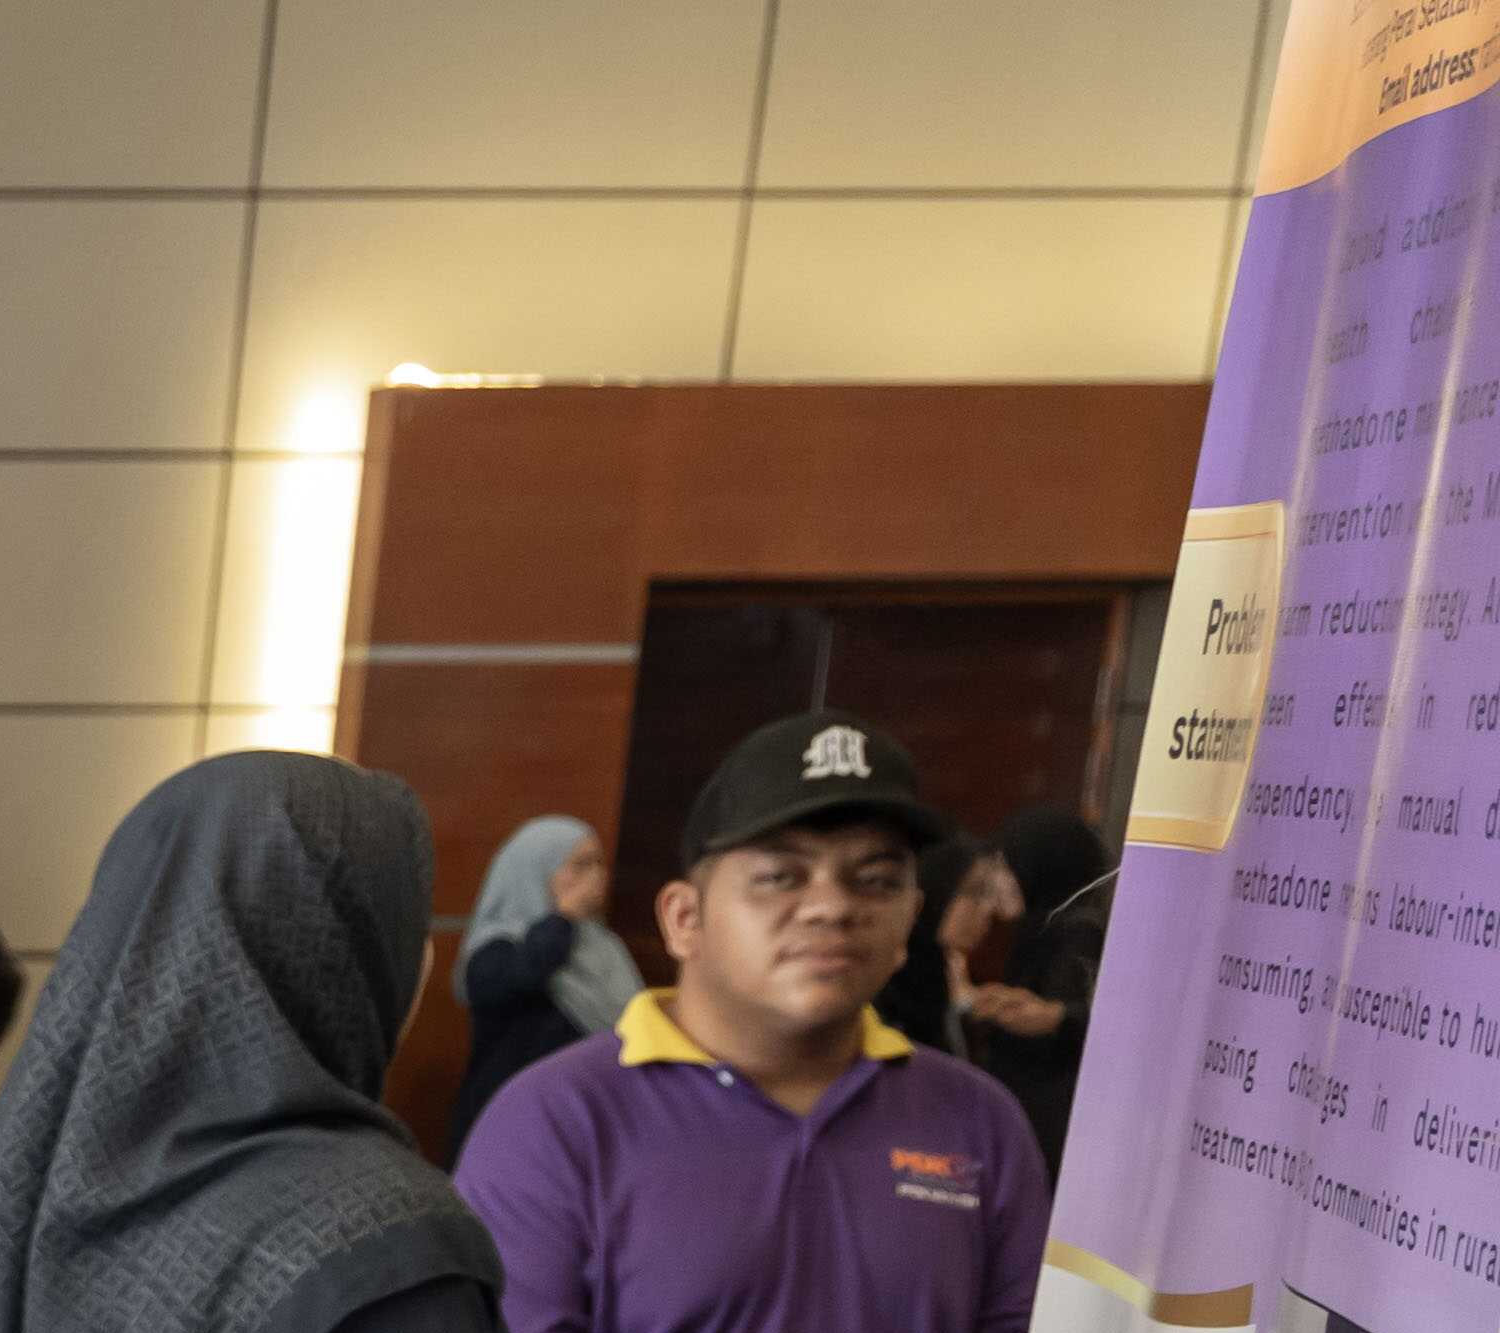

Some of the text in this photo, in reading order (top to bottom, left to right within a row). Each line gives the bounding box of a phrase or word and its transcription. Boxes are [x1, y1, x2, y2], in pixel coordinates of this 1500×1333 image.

[1416, 681, 1436, 730] in
[1398, 785, 1464, 836] manual
[1217, 953, 1315, 1014] consuming,
[1437, 1002, 1462, 1048] to
[1201, 1036, 1258, 1094] posing
[1371, 1083, 1389, 1133] in
[1190, 1119, 1279, 1180] treatment
[1280, 1145, 1297, 1187] to
[1311, 1172, 1421, 1251] communities
[1424, 1207, 1448, 1257] in
